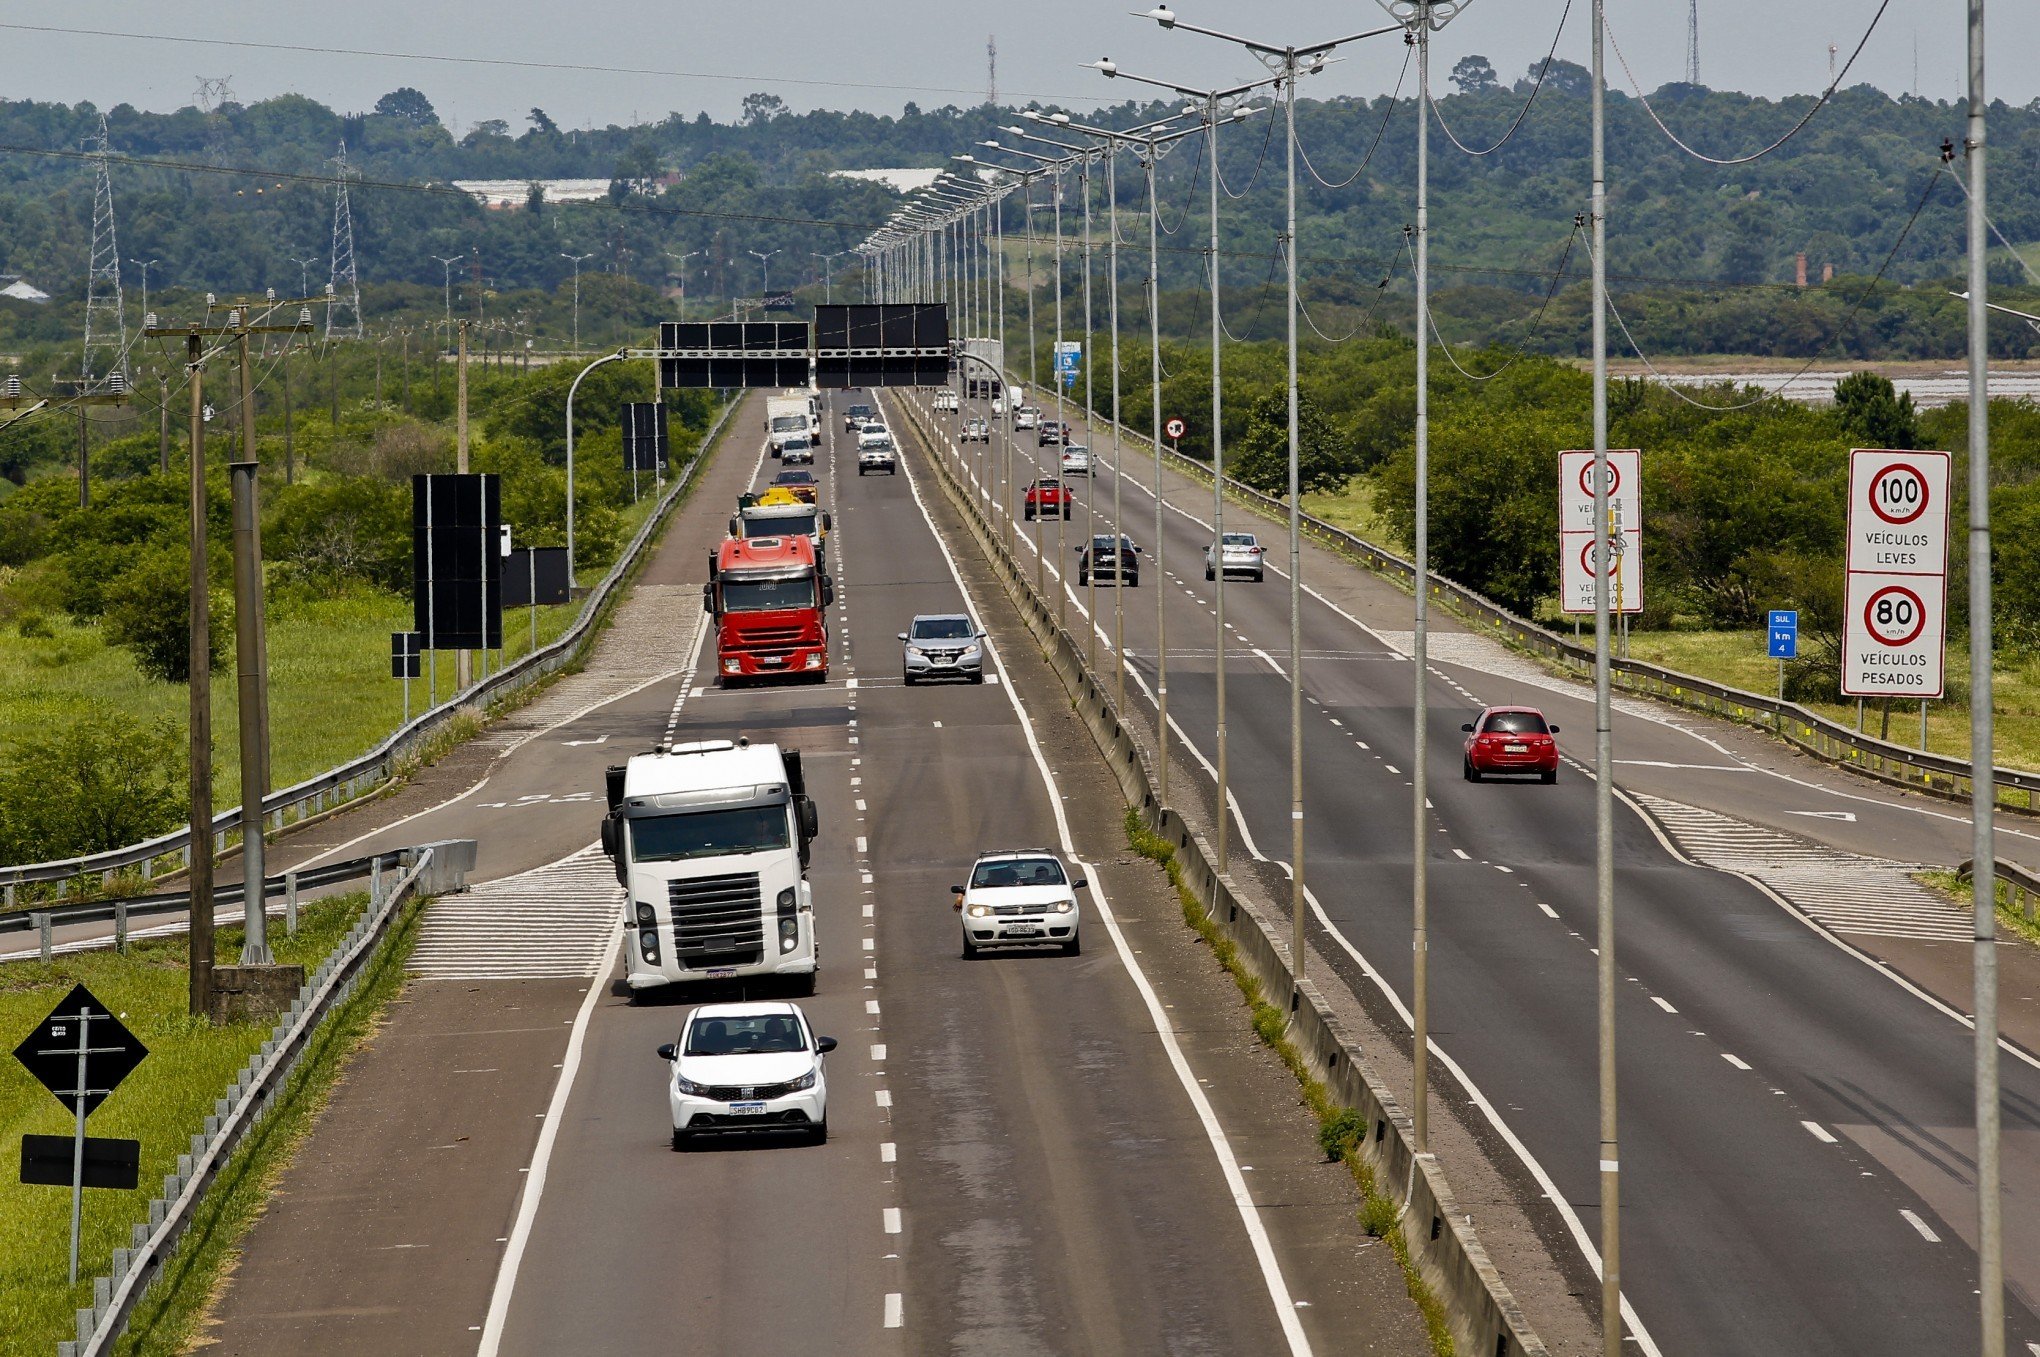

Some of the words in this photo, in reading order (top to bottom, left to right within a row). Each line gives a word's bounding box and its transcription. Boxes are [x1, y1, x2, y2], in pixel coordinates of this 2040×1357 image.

[1587, 471, 1614, 484] 10
[1882, 479, 1918, 504] 100
[1866, 530, 1928, 546] VEÍCULOS
[1877, 553, 1916, 564] LEVES
[1877, 599, 1912, 625] 80
[1775, 615, 1790, 623] SUL
[1775, 631, 1790, 640] km
[1778, 644, 1785, 652] 4
[1861, 650, 1926, 666] VEÍCULOS
[1862, 673, 1924, 685] PESADOS
